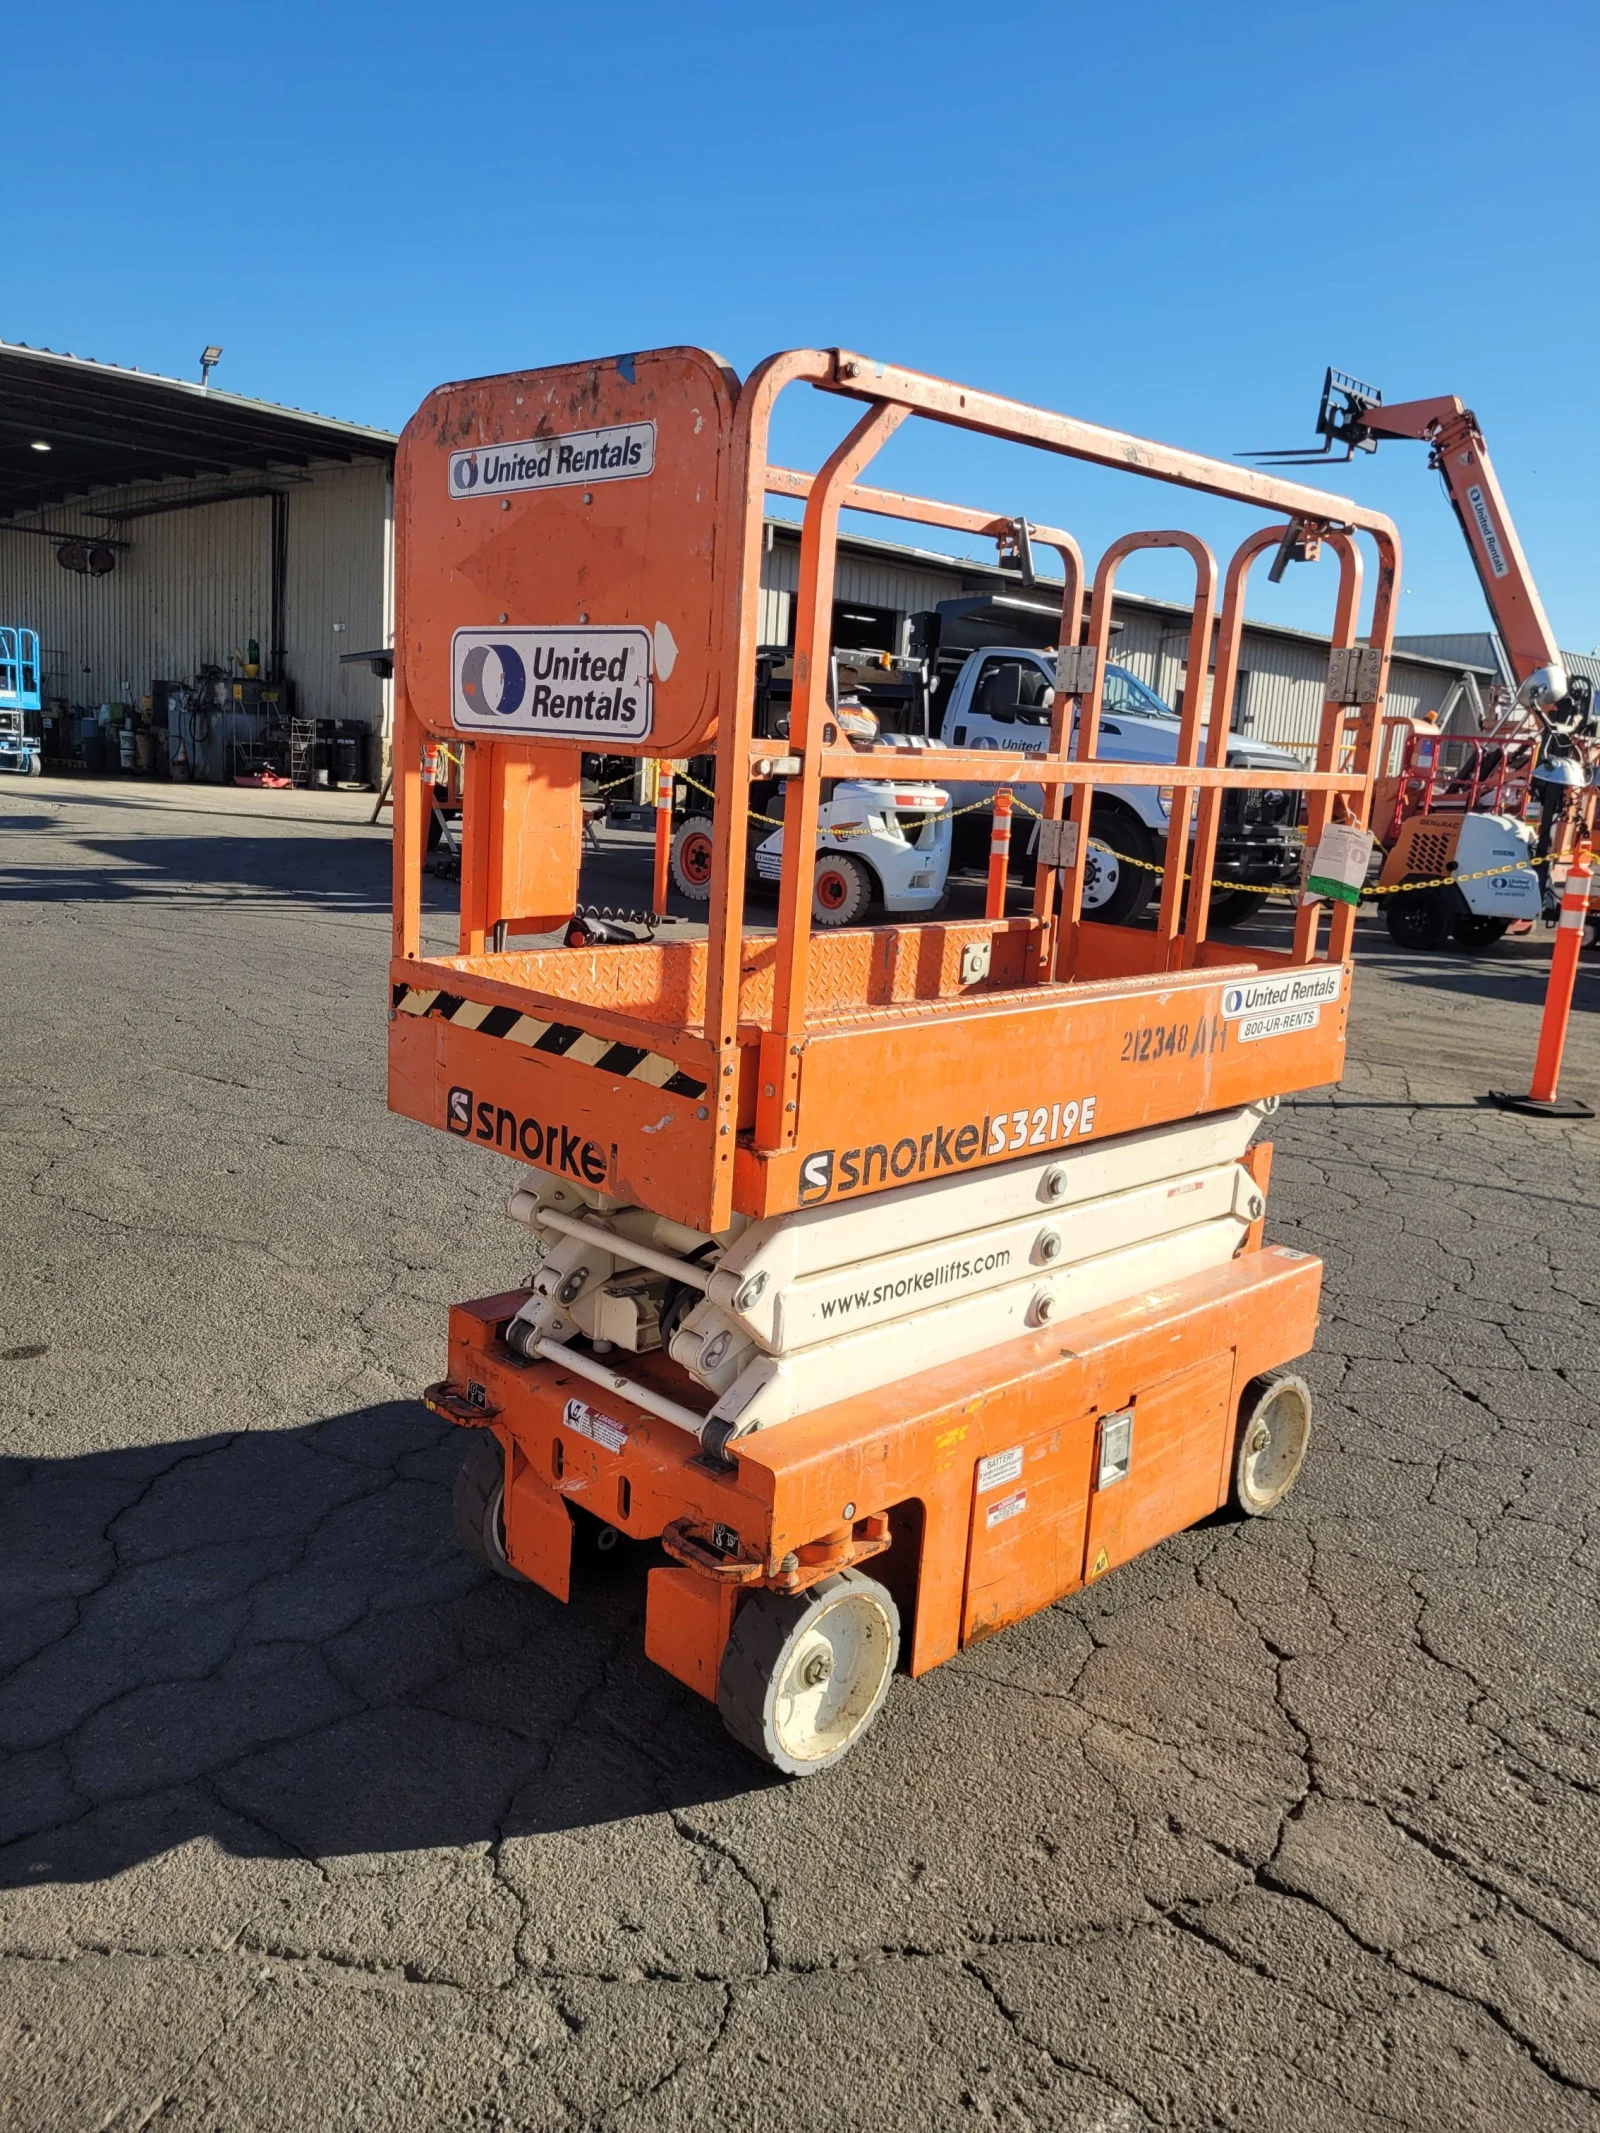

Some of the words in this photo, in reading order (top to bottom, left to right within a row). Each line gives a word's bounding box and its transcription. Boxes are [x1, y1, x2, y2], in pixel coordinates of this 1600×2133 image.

[483, 448, 552, 485] United
[556, 436, 642, 475] Rentals
[1474, 502, 1492, 536] United
[1486, 537, 1503, 573] Rentals
[533, 647, 629, 682] United
[531, 684, 637, 722] Rentals
[1001, 738, 1042, 752] United
[1245, 983, 1289, 1009] United
[1291, 976, 1335, 1001] Rentals
[1244, 1010, 1315, 1037] 800-UR-RENTS
[838, 1115, 990, 1192] snorkel
[988, 1095, 1097, 1156] S3219E
[820, 1249, 1011, 1319] www.snorkellifts.com
[598, 1414, 624, 1431] DANGER
[986, 1451, 1015, 1470] BATTERY
